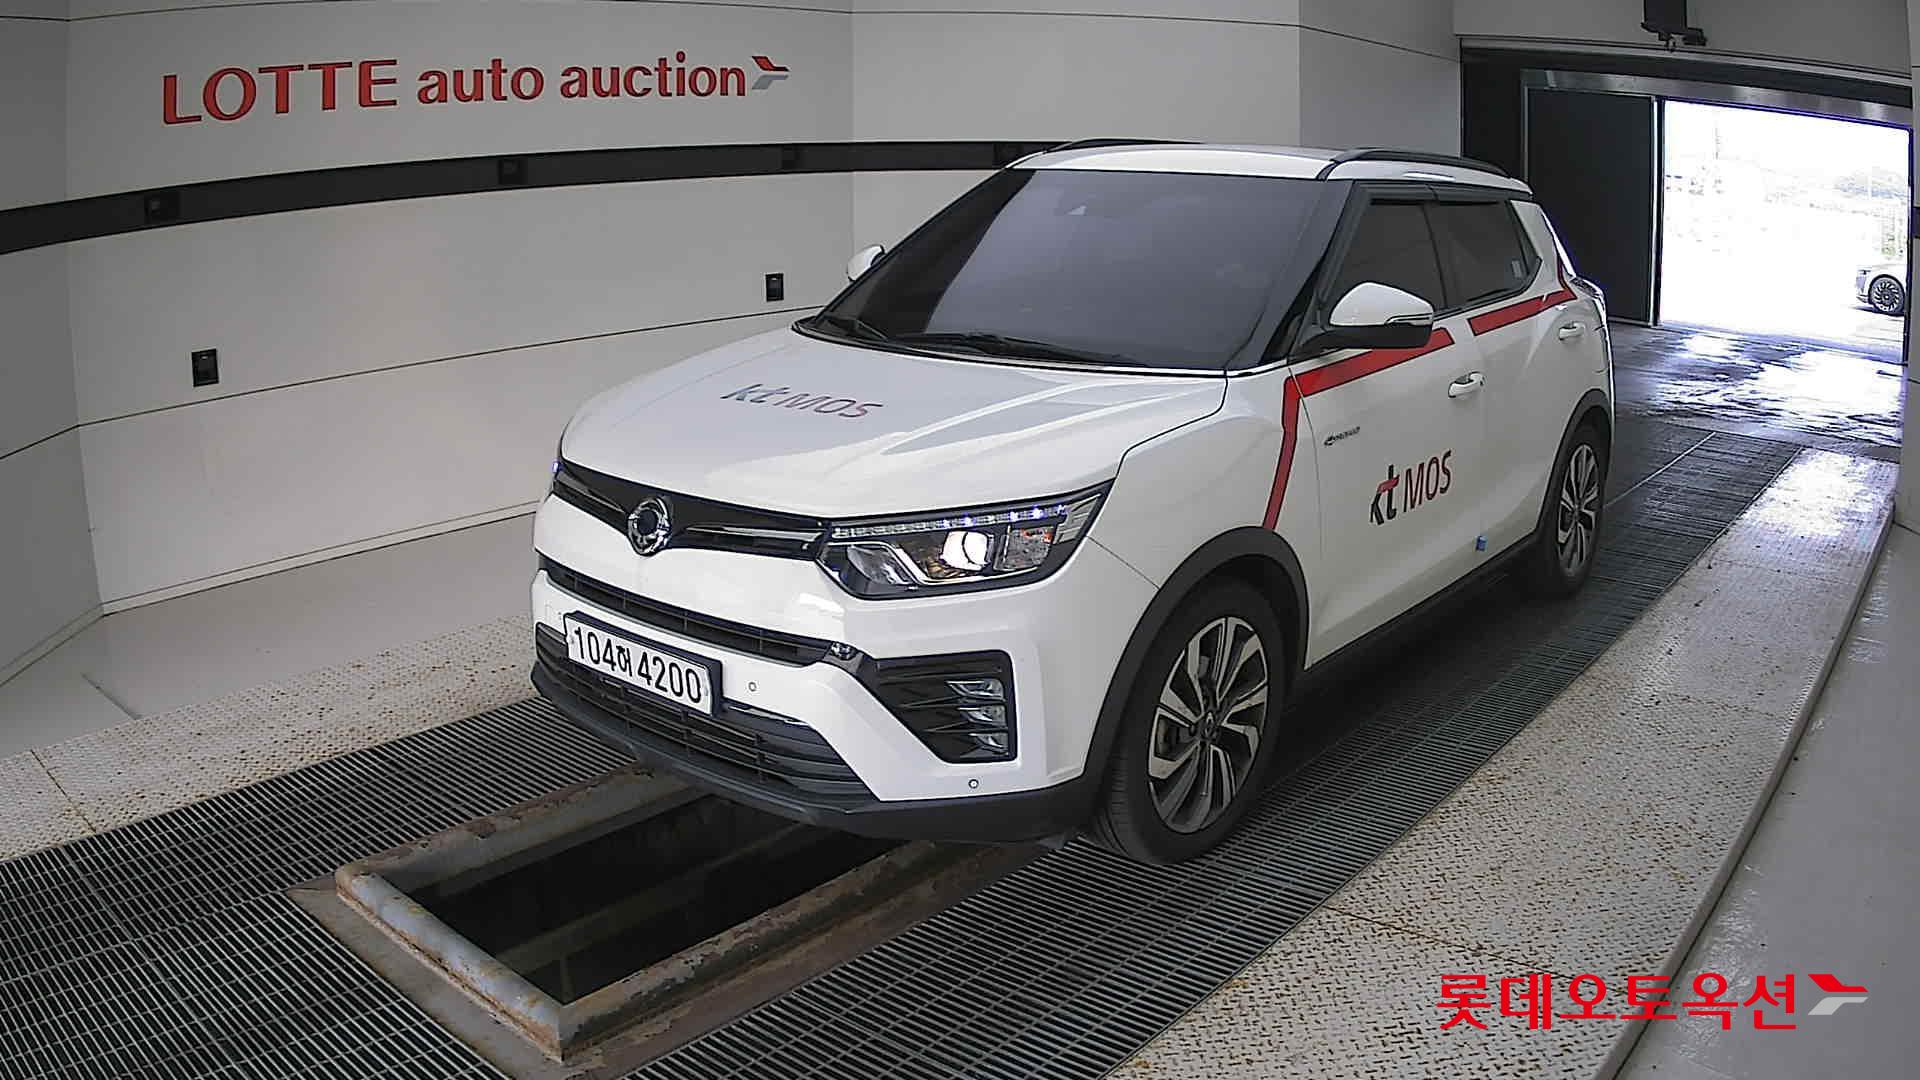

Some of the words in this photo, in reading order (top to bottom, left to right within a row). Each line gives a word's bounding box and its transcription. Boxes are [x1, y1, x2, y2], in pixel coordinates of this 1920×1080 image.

[163, 60, 397, 125] LOTTE
[417, 58, 544, 104] auto
[560, 50, 746, 98] auction
[719, 383, 790, 404] kt
[772, 393, 884, 418] MOS
[1369, 464, 1400, 525] kt
[1403, 449, 1452, 513] MOS
[574, 626, 633, 677] 104허
[637, 651, 702, 704] 4200
